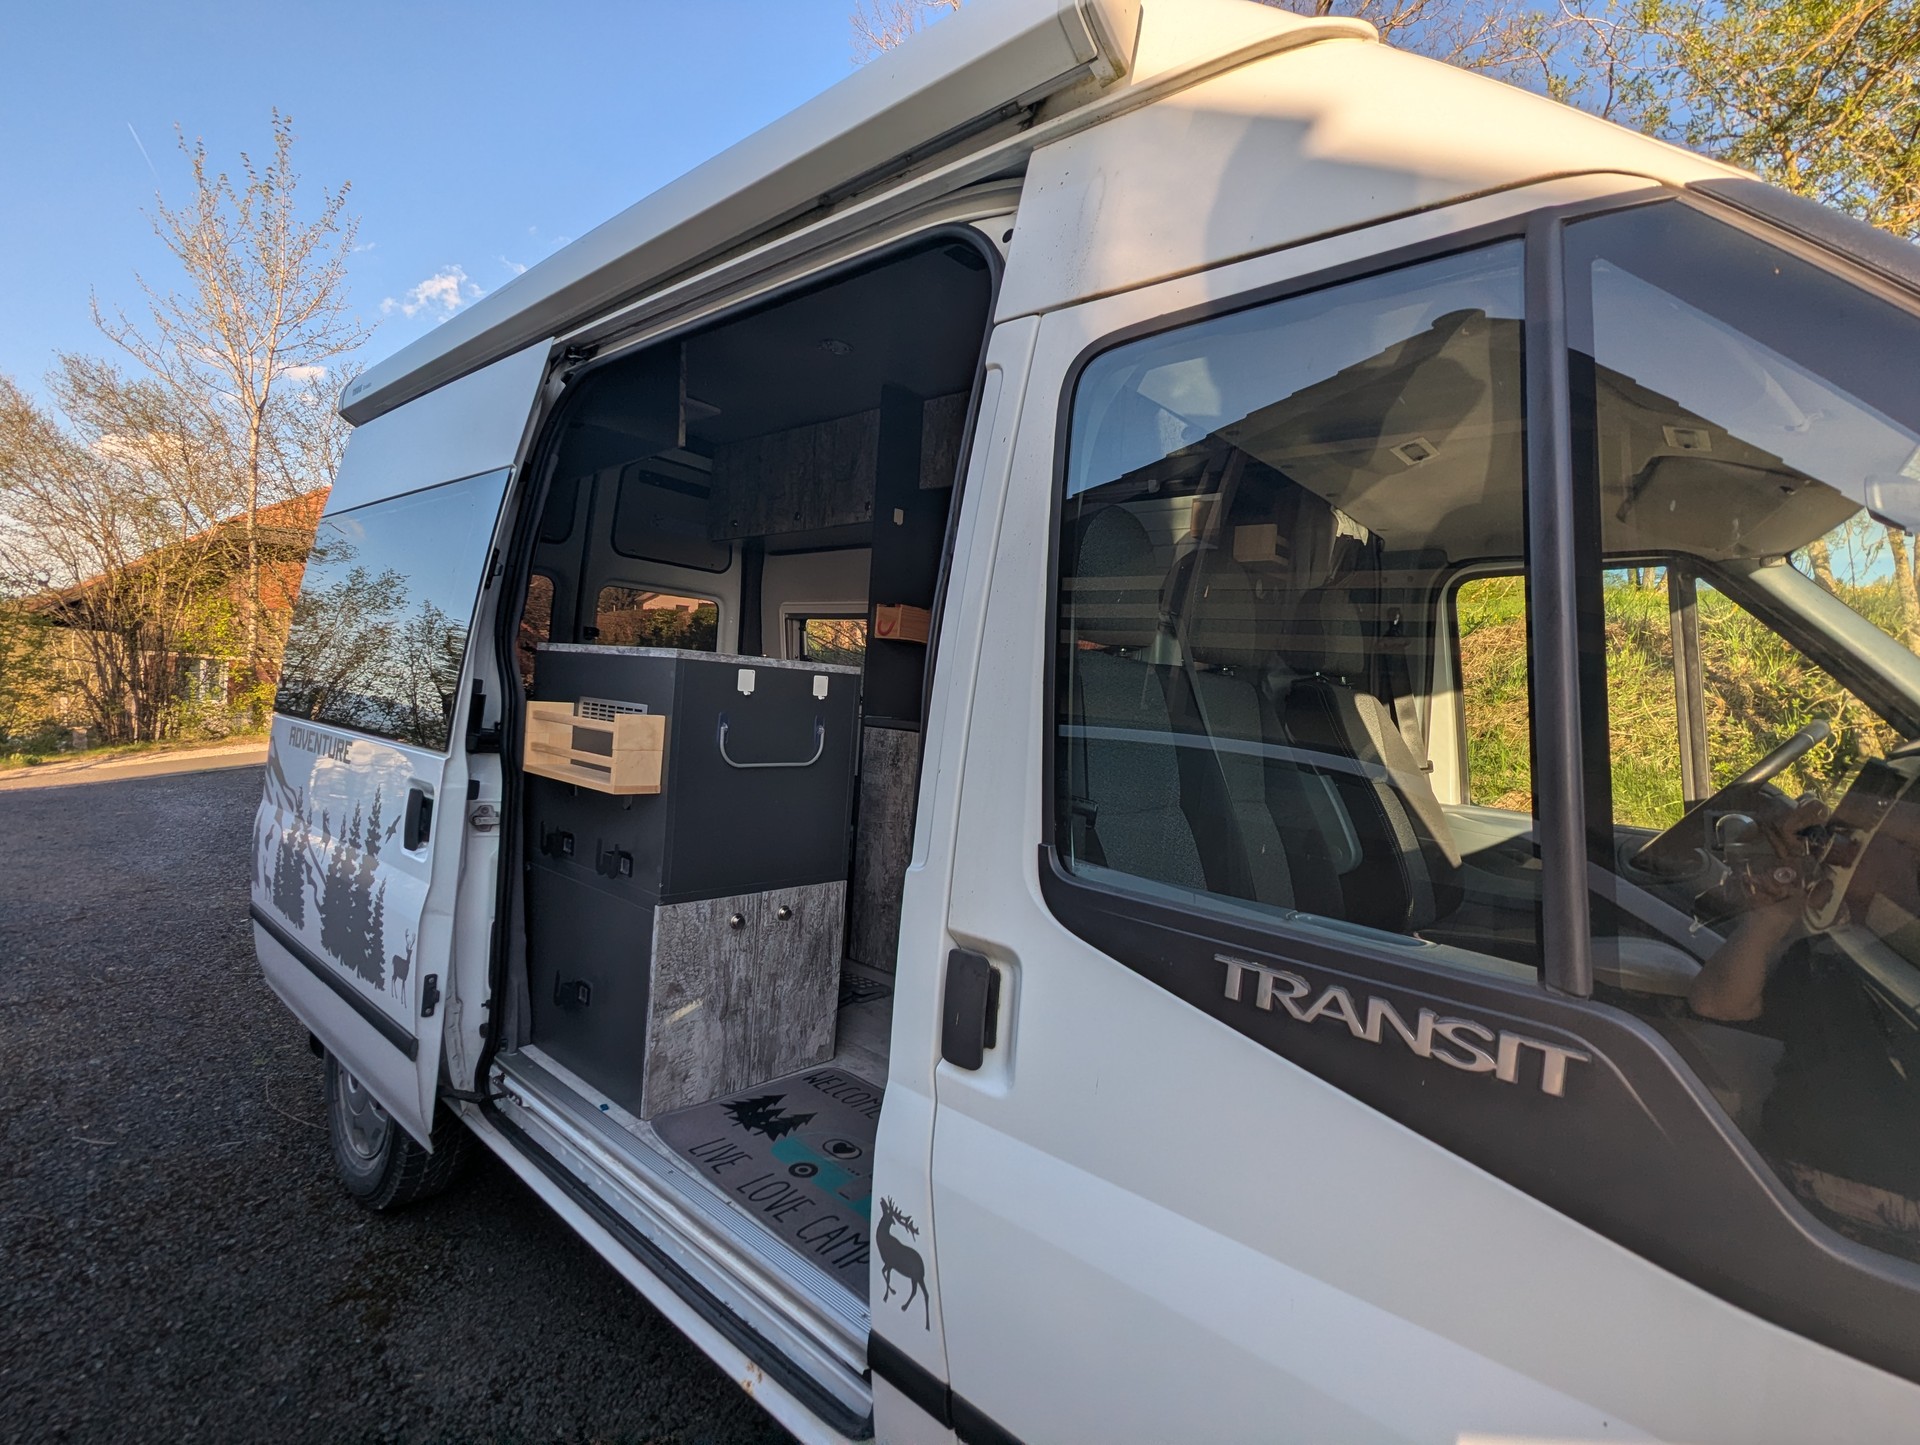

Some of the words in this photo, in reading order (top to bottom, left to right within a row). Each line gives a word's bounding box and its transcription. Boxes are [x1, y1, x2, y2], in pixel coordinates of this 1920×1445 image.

[289, 726, 353, 764] ADVENTURE
[1213, 953, 1590, 1097] TRANSIT
[688, 1137, 753, 1174] LIVE
[737, 1173, 816, 1223] LOVE
